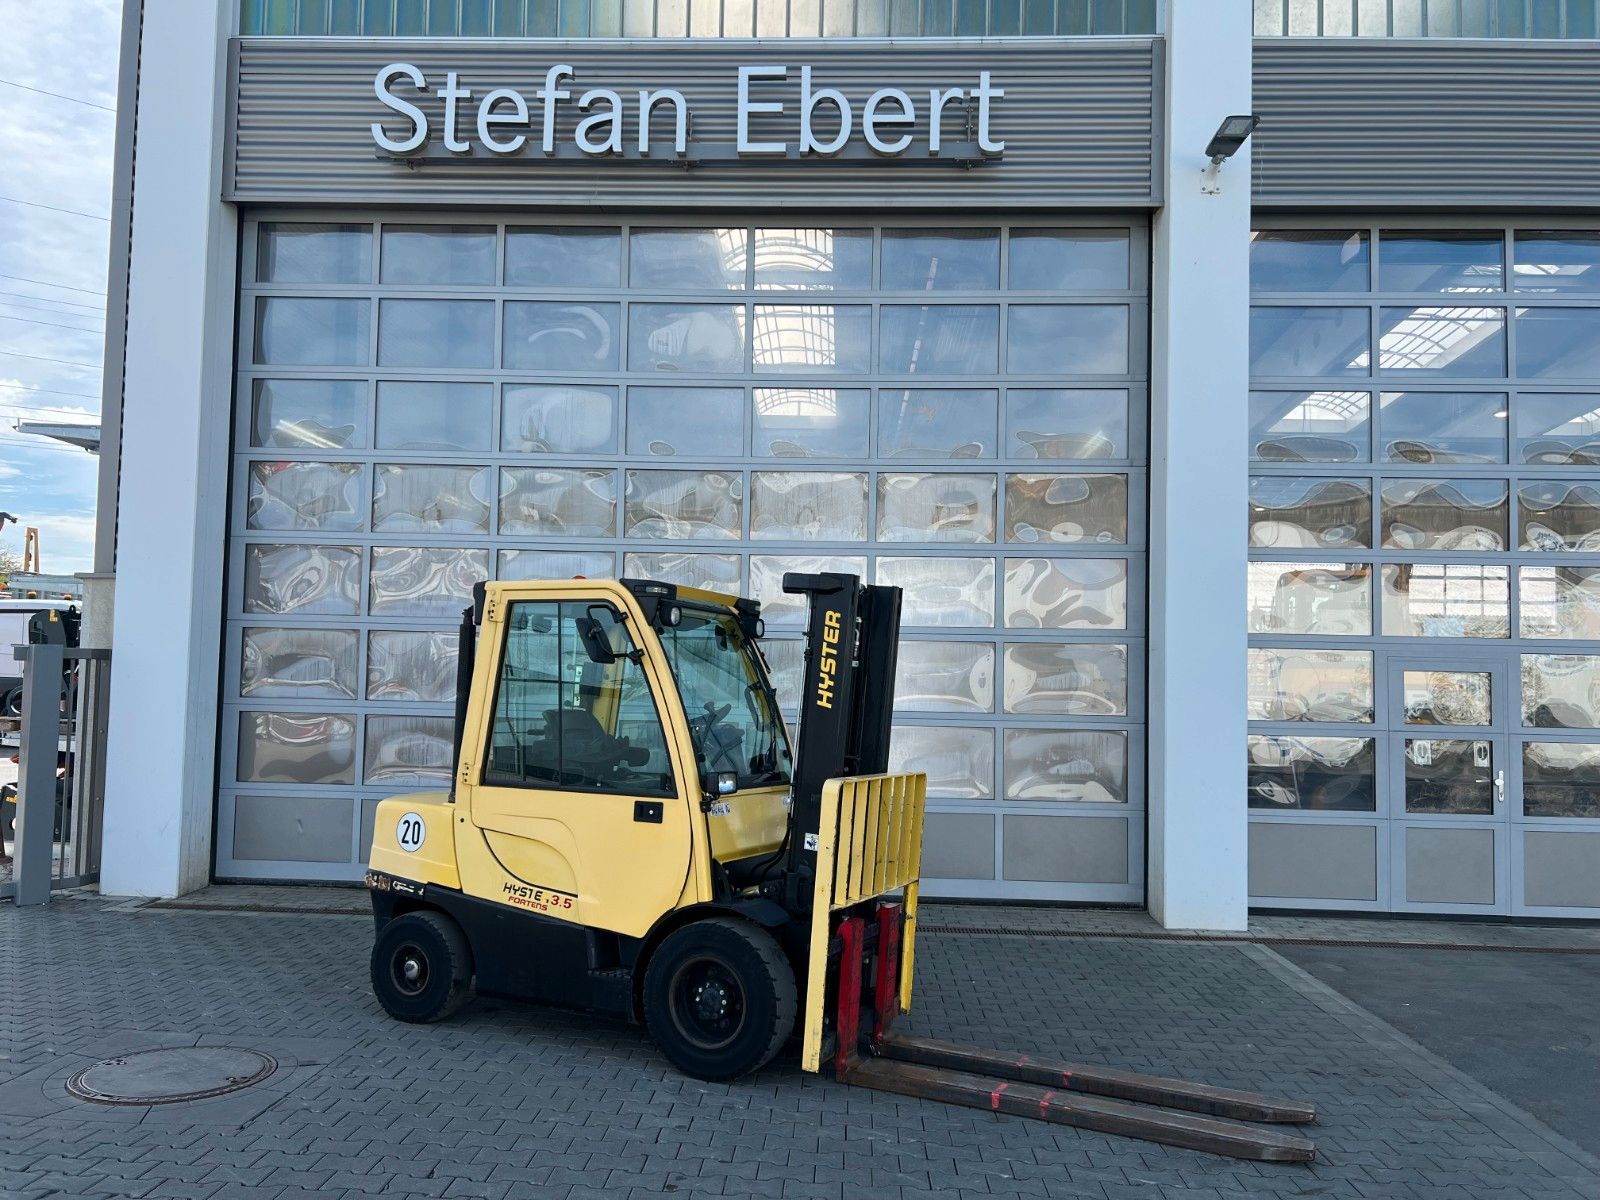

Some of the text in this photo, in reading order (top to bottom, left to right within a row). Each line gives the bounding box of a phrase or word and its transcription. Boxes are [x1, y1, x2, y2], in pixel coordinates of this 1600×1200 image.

[371, 63, 1005, 154] Stefan Ebert
[817, 610, 841, 709] HYSTER
[401, 820, 421, 845] 20
[503, 882, 573, 909] HYSTE 3.5
[508, 896, 548, 911] FORTENS
